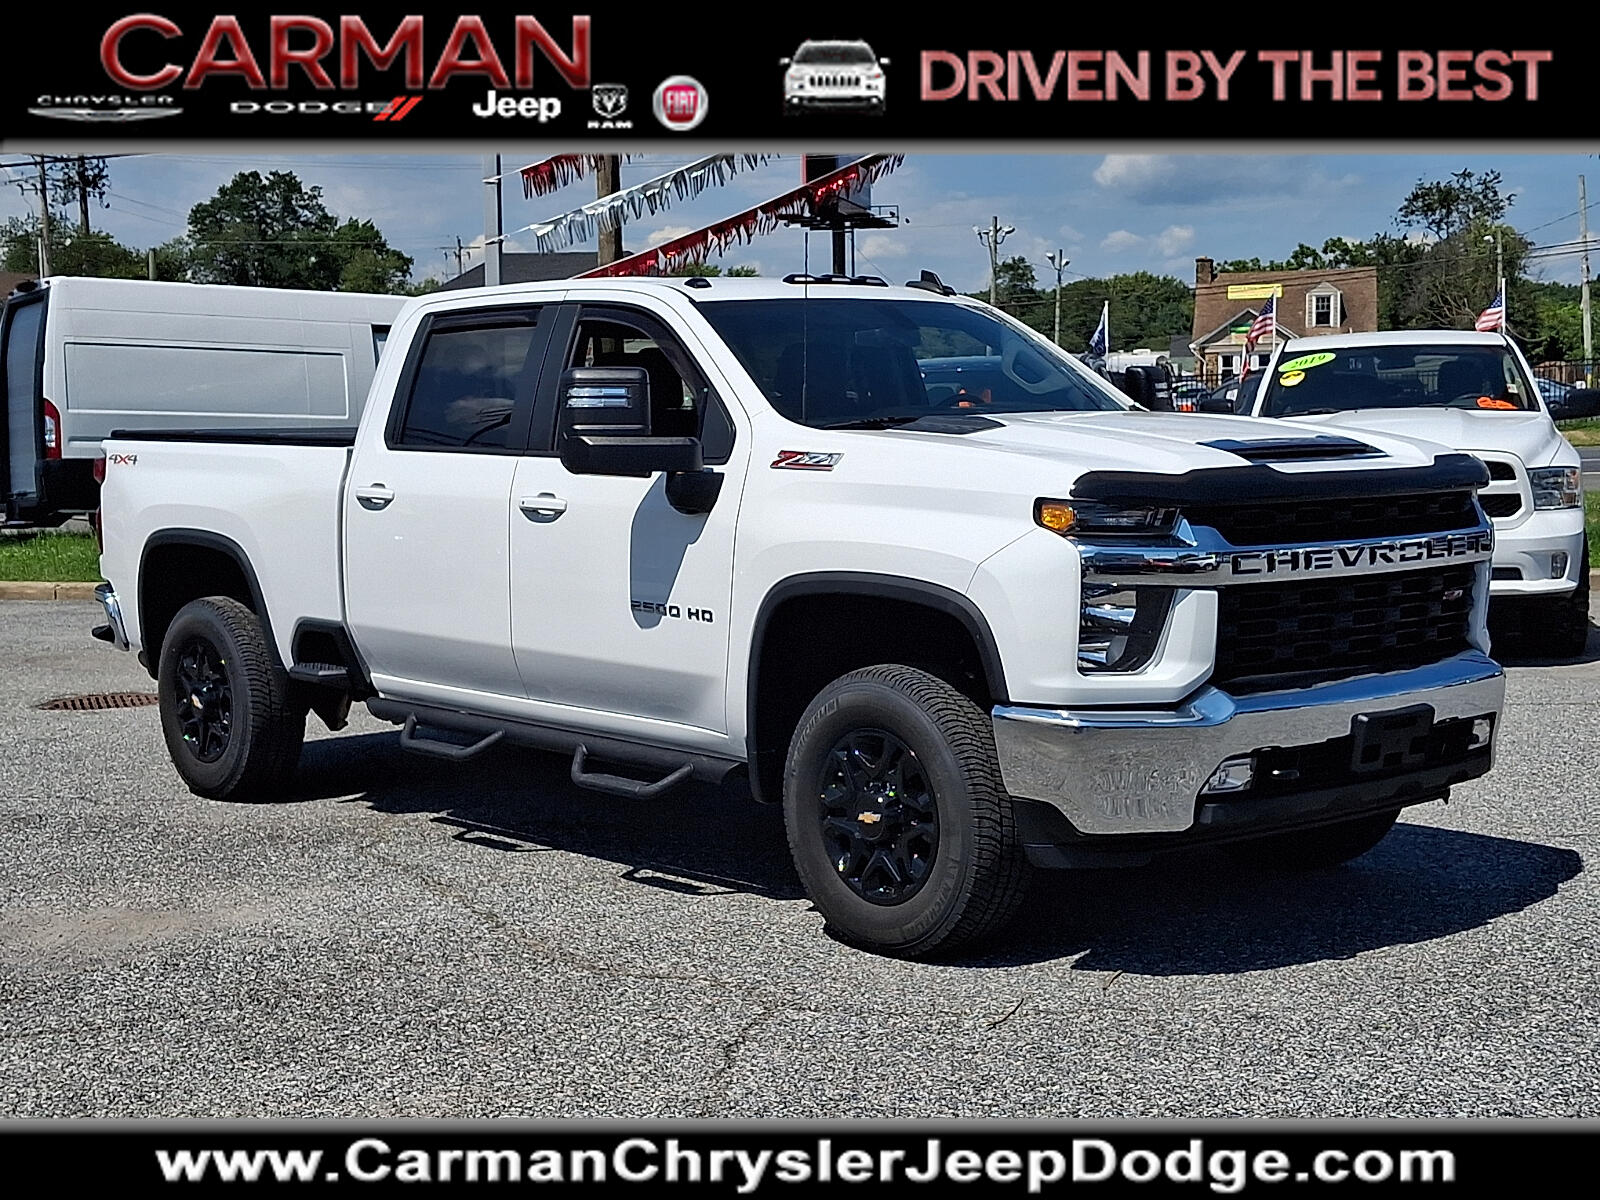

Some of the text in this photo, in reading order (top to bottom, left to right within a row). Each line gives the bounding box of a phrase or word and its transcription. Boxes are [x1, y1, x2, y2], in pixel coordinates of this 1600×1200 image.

[1231, 533, 1490, 575] CHEVROLET
[631, 600, 714, 623] 2500 HD
